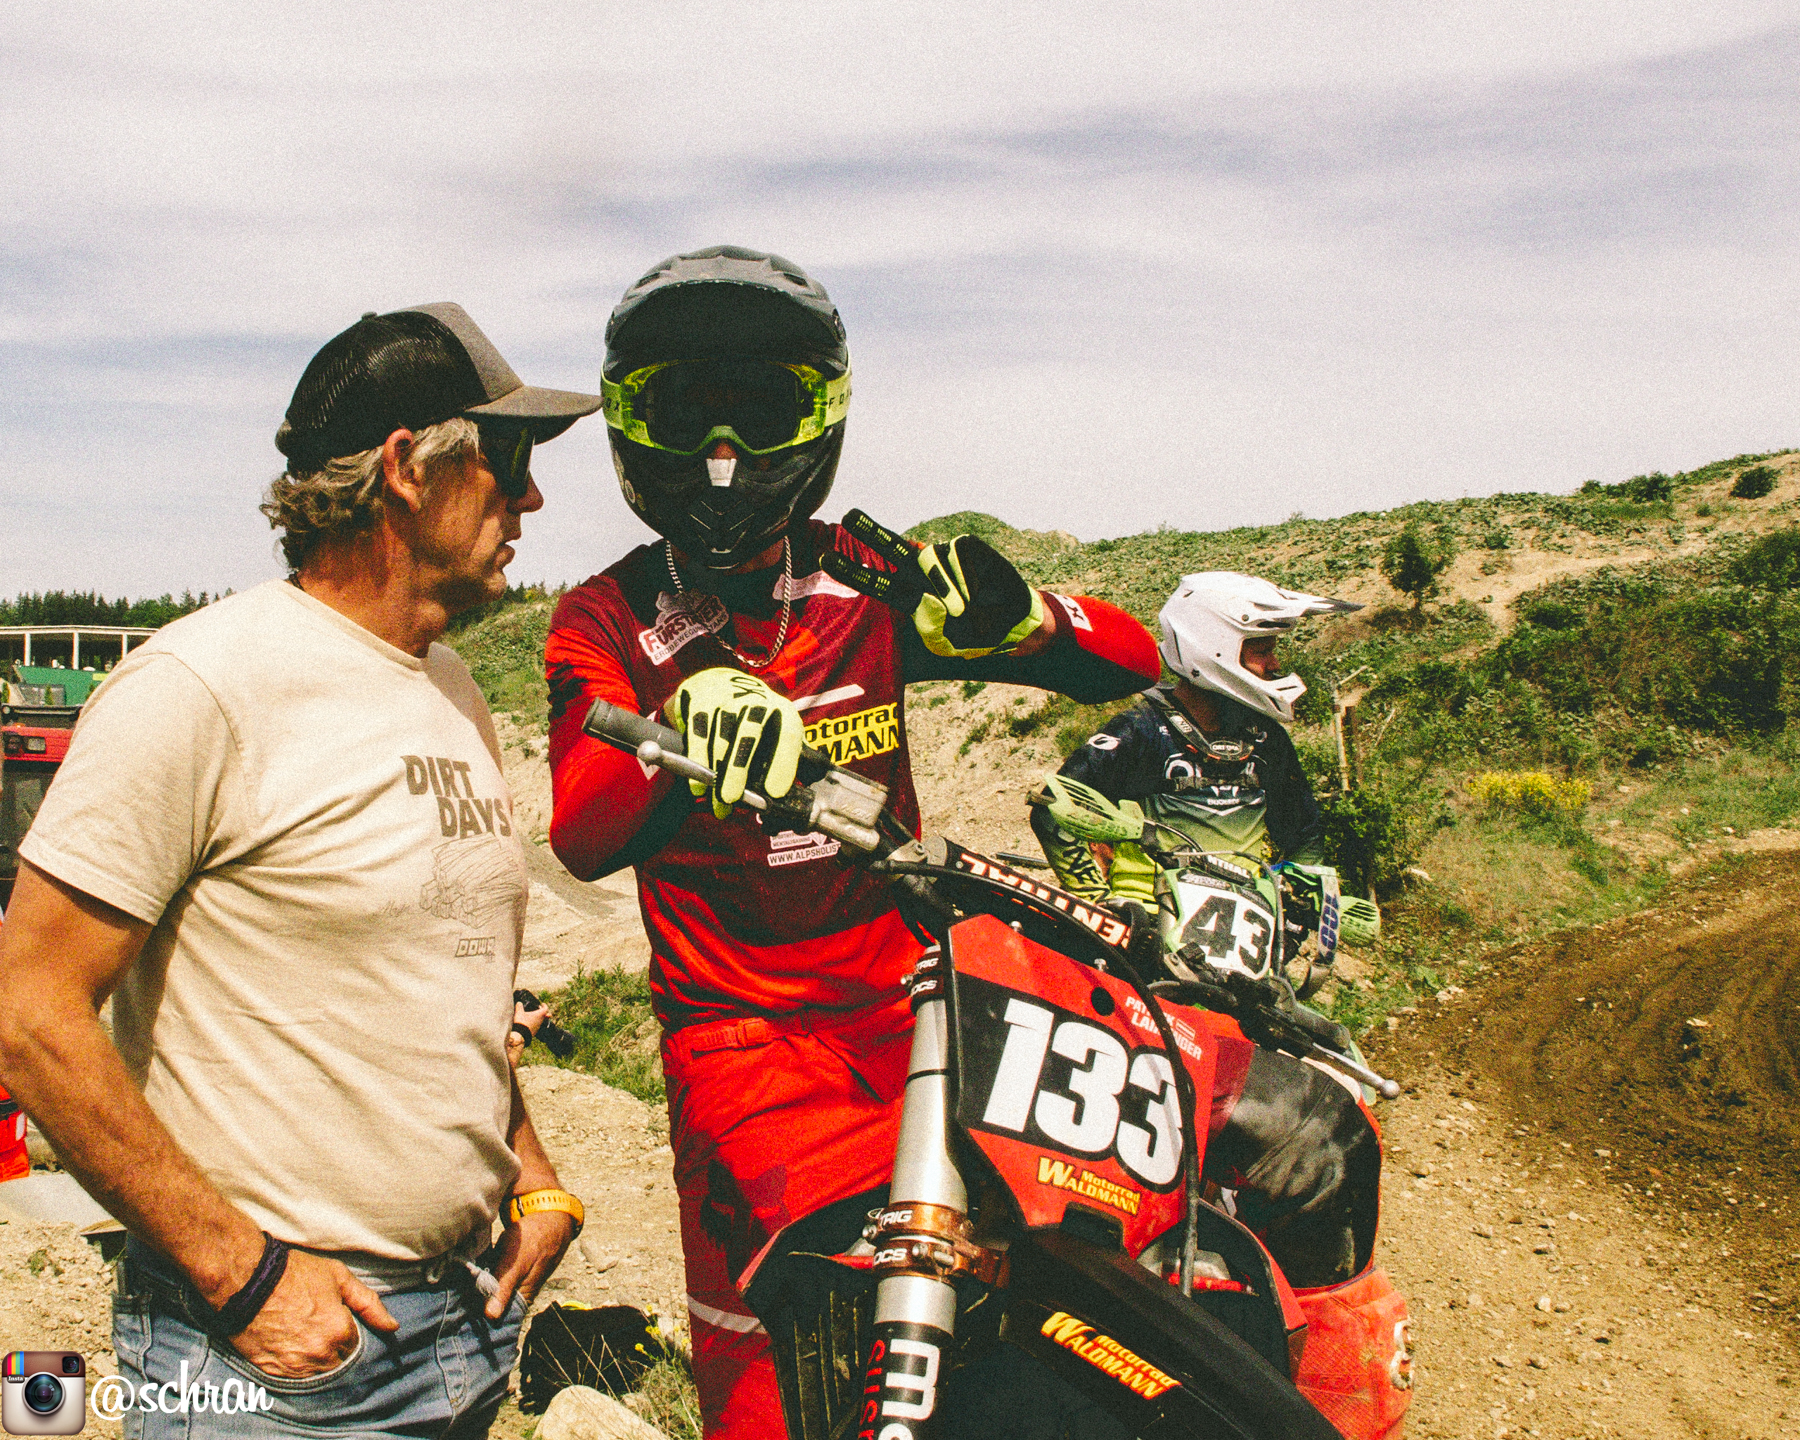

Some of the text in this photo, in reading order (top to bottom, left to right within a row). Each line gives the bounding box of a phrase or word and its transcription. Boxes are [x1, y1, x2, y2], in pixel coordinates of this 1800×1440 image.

[804, 704, 898, 743] otorra
[400, 755, 475, 799] DIRT
[436, 796, 511, 839] DAYS
[1180, 895, 1272, 975] 43
[982, 998, 1184, 1186] 133
[1037, 1156, 1139, 1216] WALDMANN
[1080, 1169, 1141, 1204] Motorrad
[1040, 1311, 1165, 1400] WALDMANN
[1094, 1334, 1182, 1388] Motorrad
